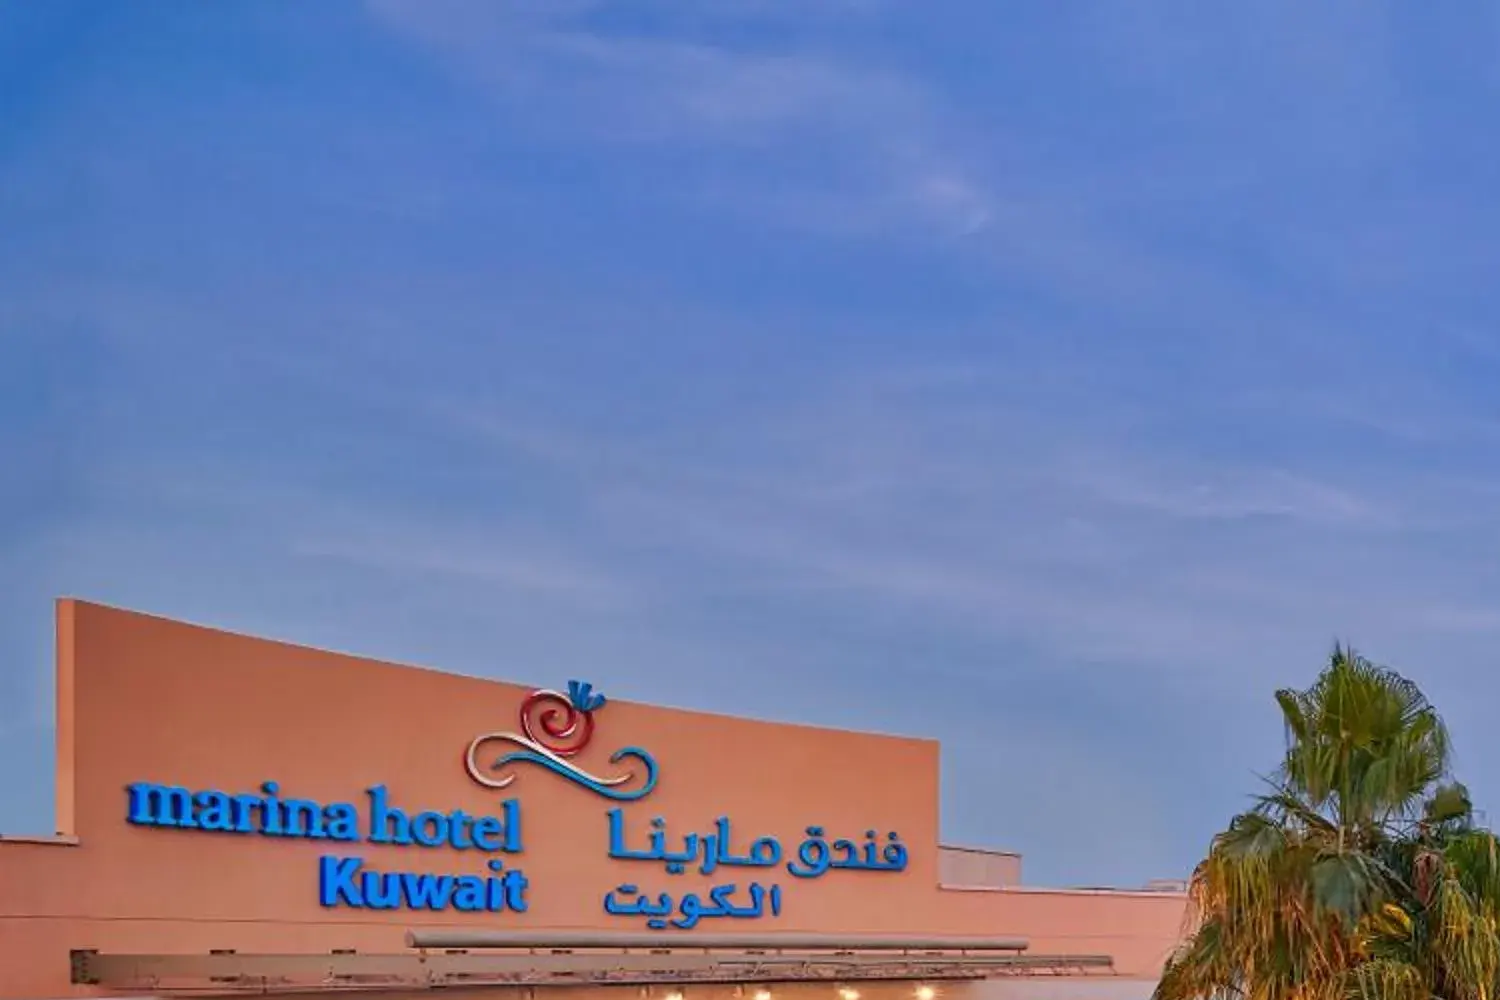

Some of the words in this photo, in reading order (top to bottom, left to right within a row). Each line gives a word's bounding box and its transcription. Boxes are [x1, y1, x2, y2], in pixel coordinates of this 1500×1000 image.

[127, 780, 361, 843] marina
[367, 784, 525, 854] hotel
[606, 807, 784, 875] مارينا
[787, 826, 909, 879] فندق
[319, 855, 530, 913] Kuwait
[603, 883, 783, 929] الكويت
